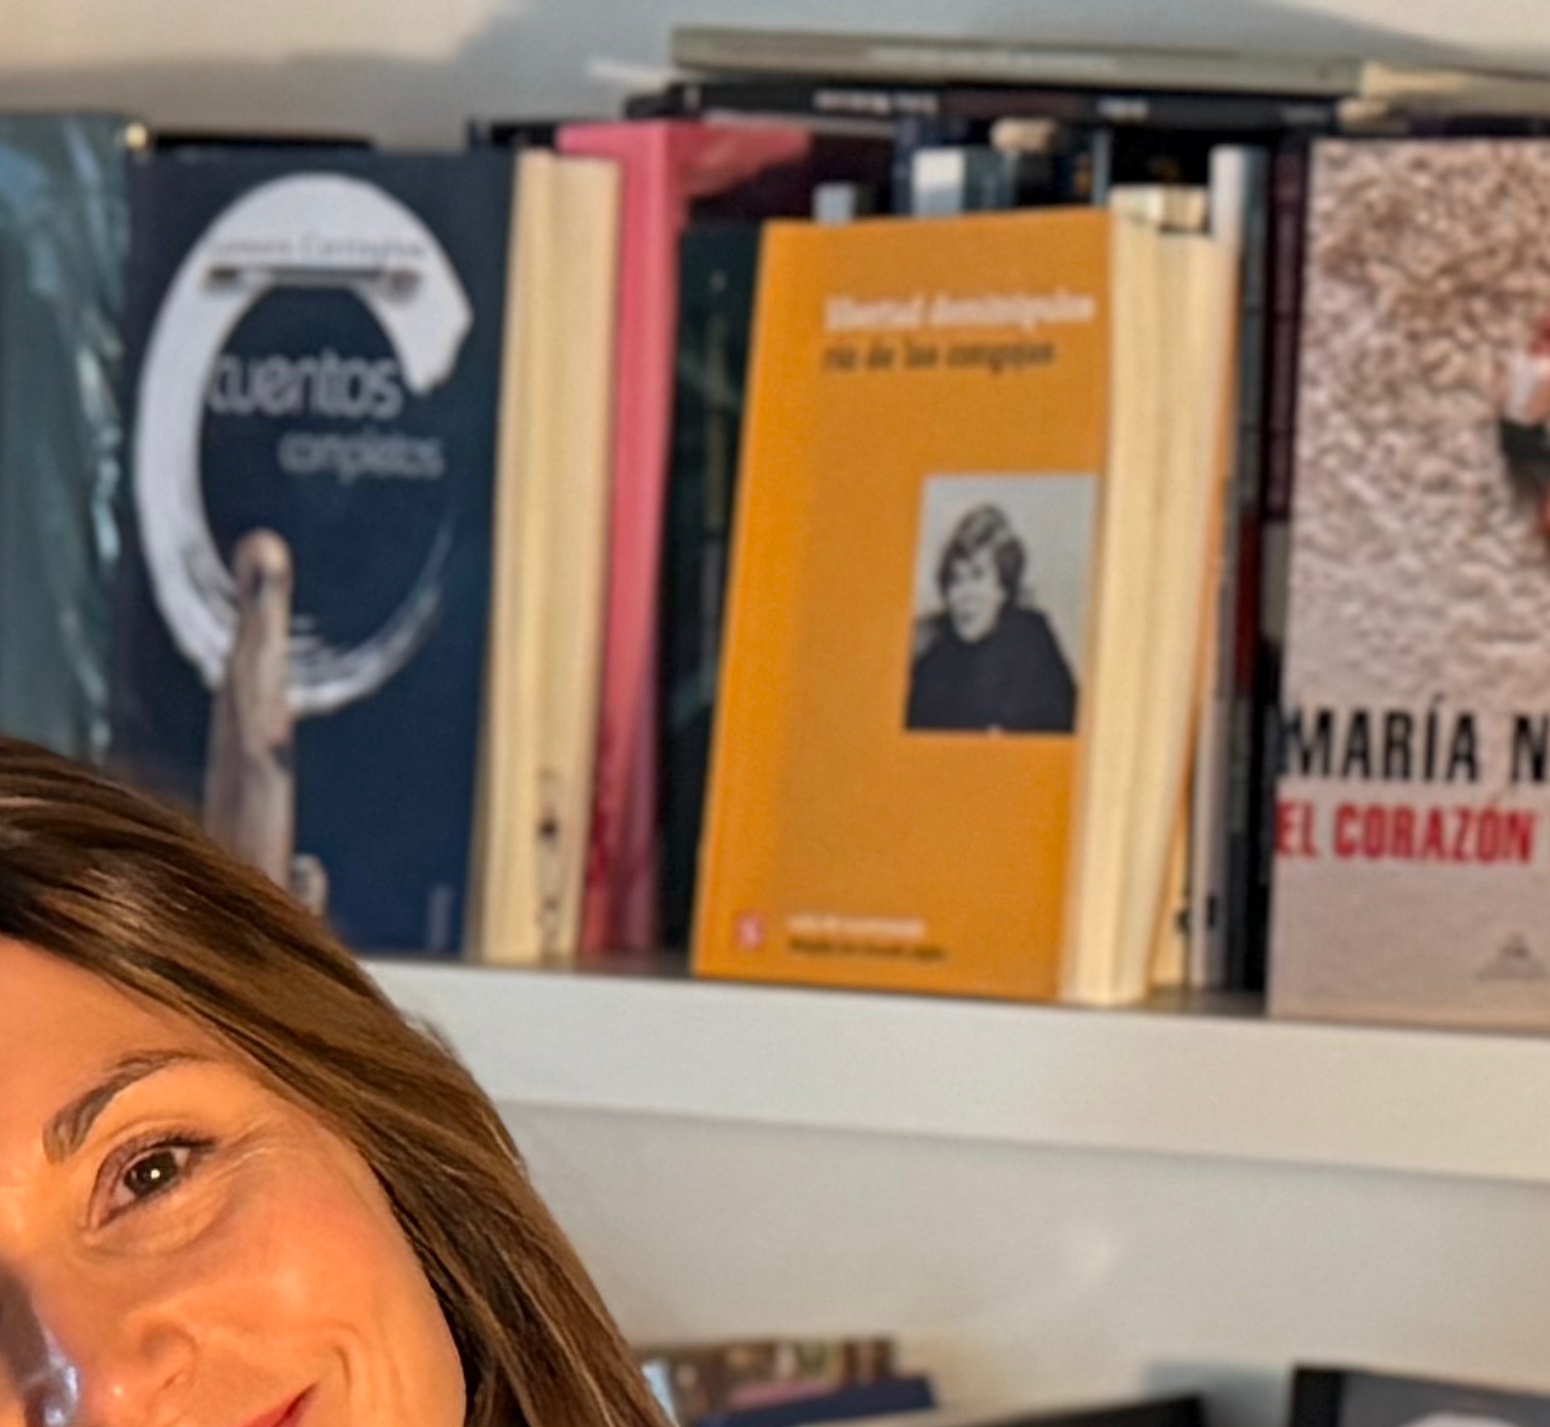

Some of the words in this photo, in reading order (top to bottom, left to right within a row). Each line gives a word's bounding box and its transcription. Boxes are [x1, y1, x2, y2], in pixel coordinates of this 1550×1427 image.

[1283, 694, 1480, 784] MARÍA
[1275, 801, 1318, 857] EL
[1333, 794, 1535, 862] CORAZÓN
